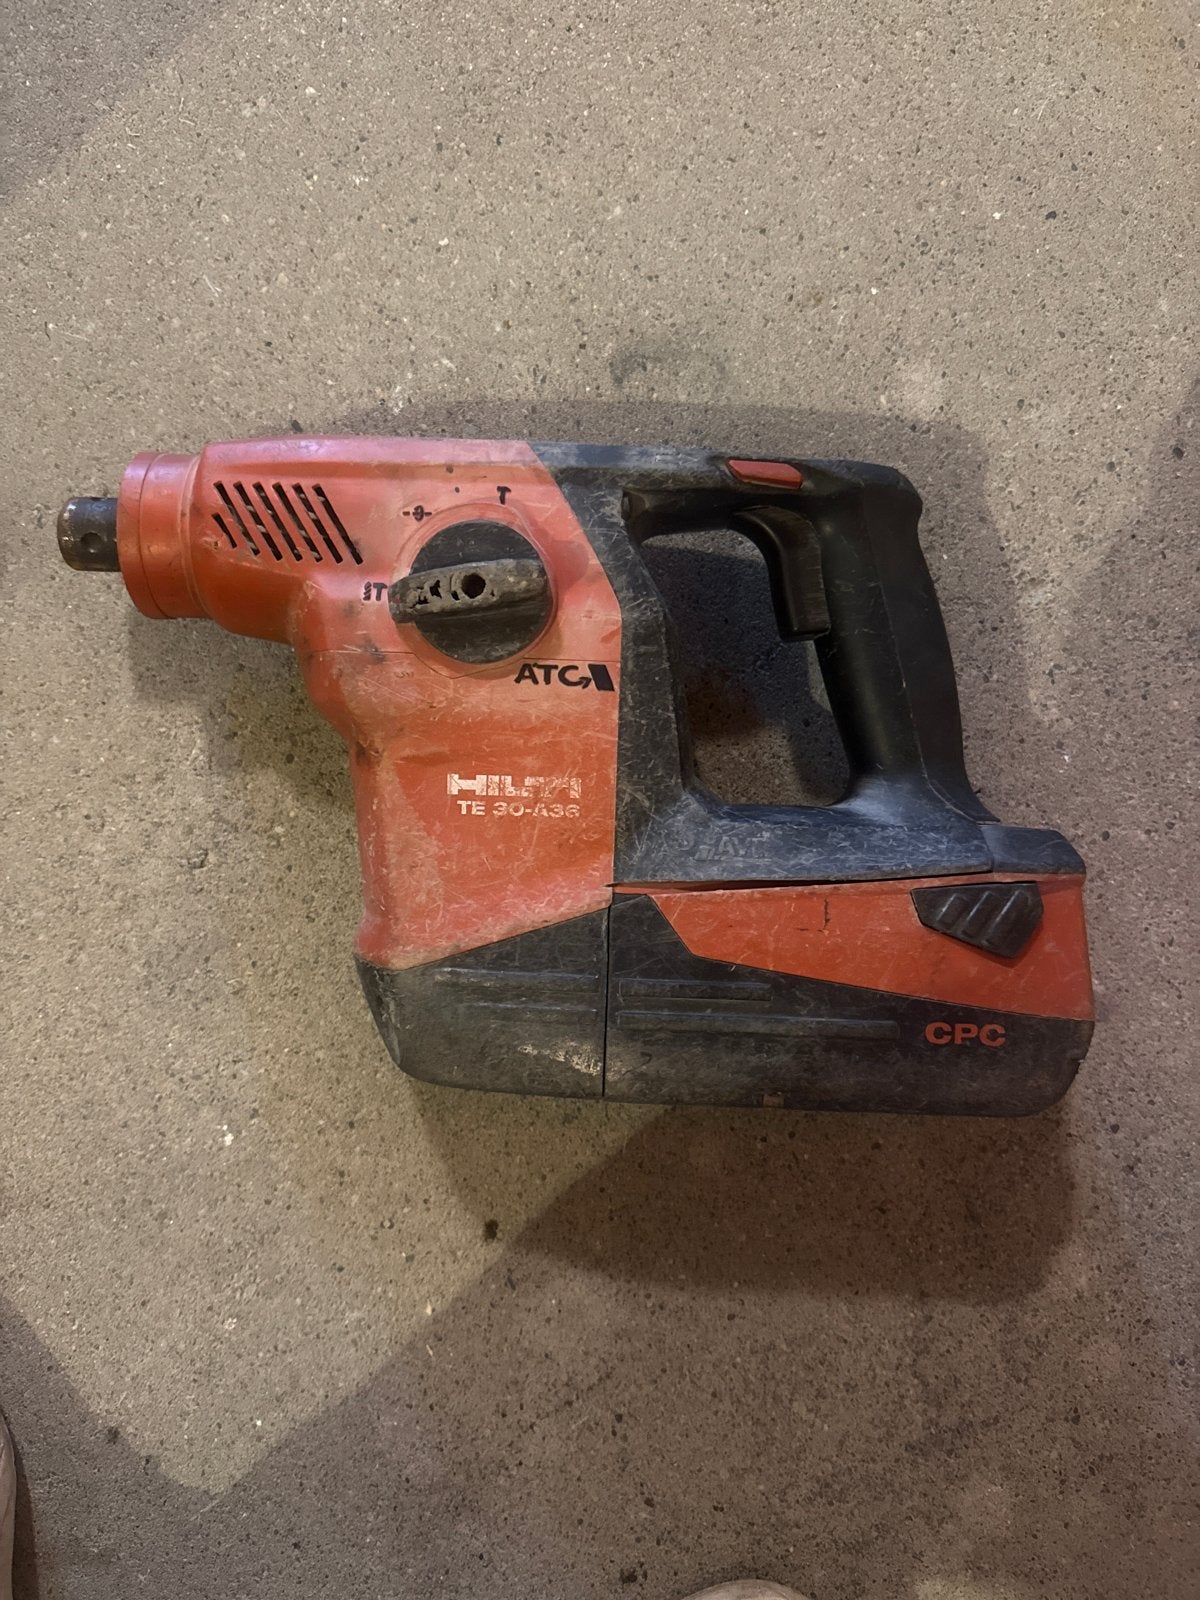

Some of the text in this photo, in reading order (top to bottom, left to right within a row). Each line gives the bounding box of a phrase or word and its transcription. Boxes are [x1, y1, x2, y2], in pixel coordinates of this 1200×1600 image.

[514, 662, 591, 689] ATC
[457, 800, 581, 818] TE 30-A36
[925, 1021, 1006, 1047] CPC
